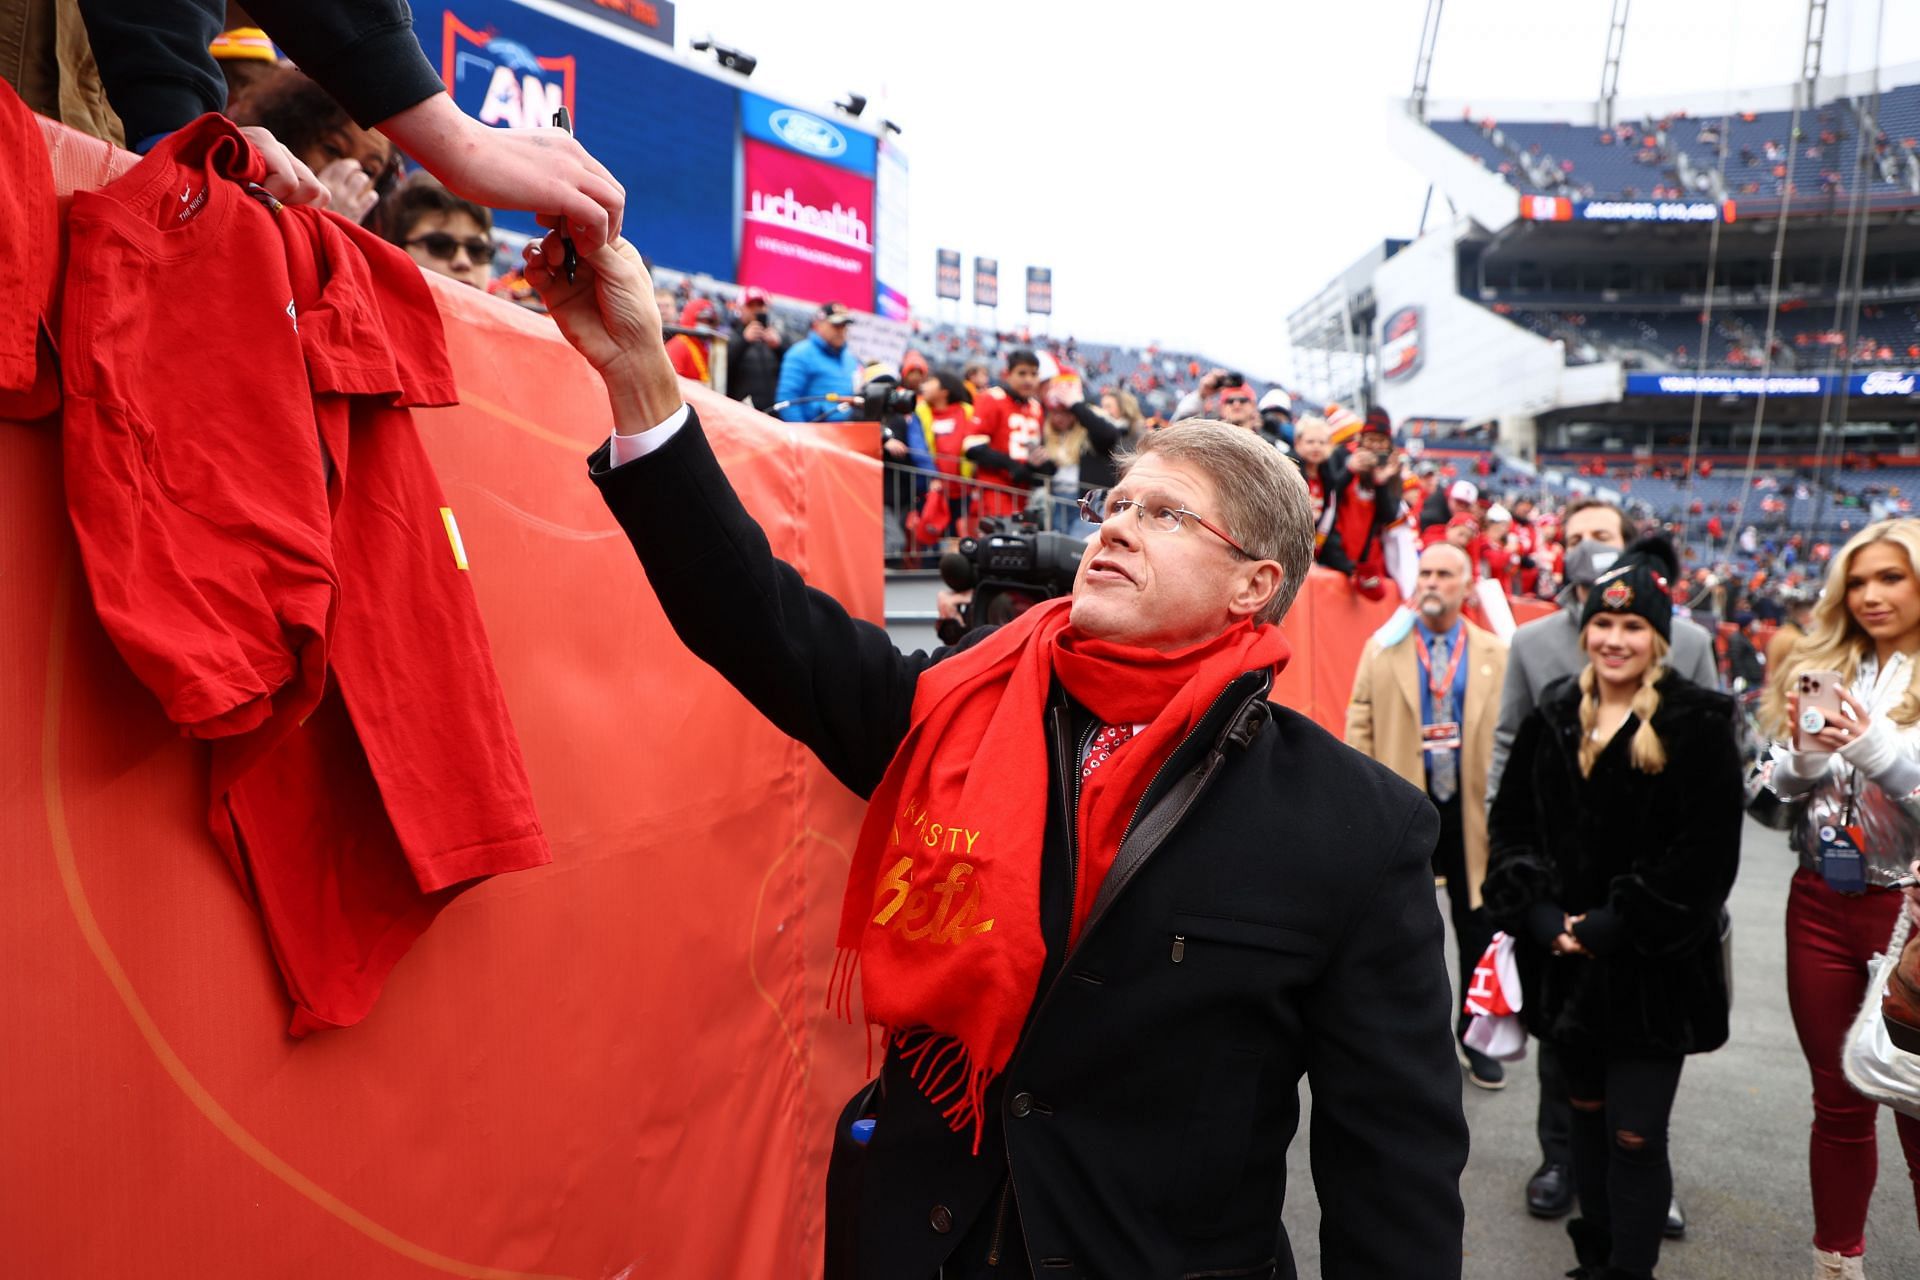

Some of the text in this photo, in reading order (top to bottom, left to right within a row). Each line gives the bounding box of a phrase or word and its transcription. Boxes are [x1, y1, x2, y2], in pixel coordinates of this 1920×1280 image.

[179, 192, 204, 221] THE NIKE
[752, 187, 867, 243] uchealth
[1861, 371, 1915, 394] Ford
